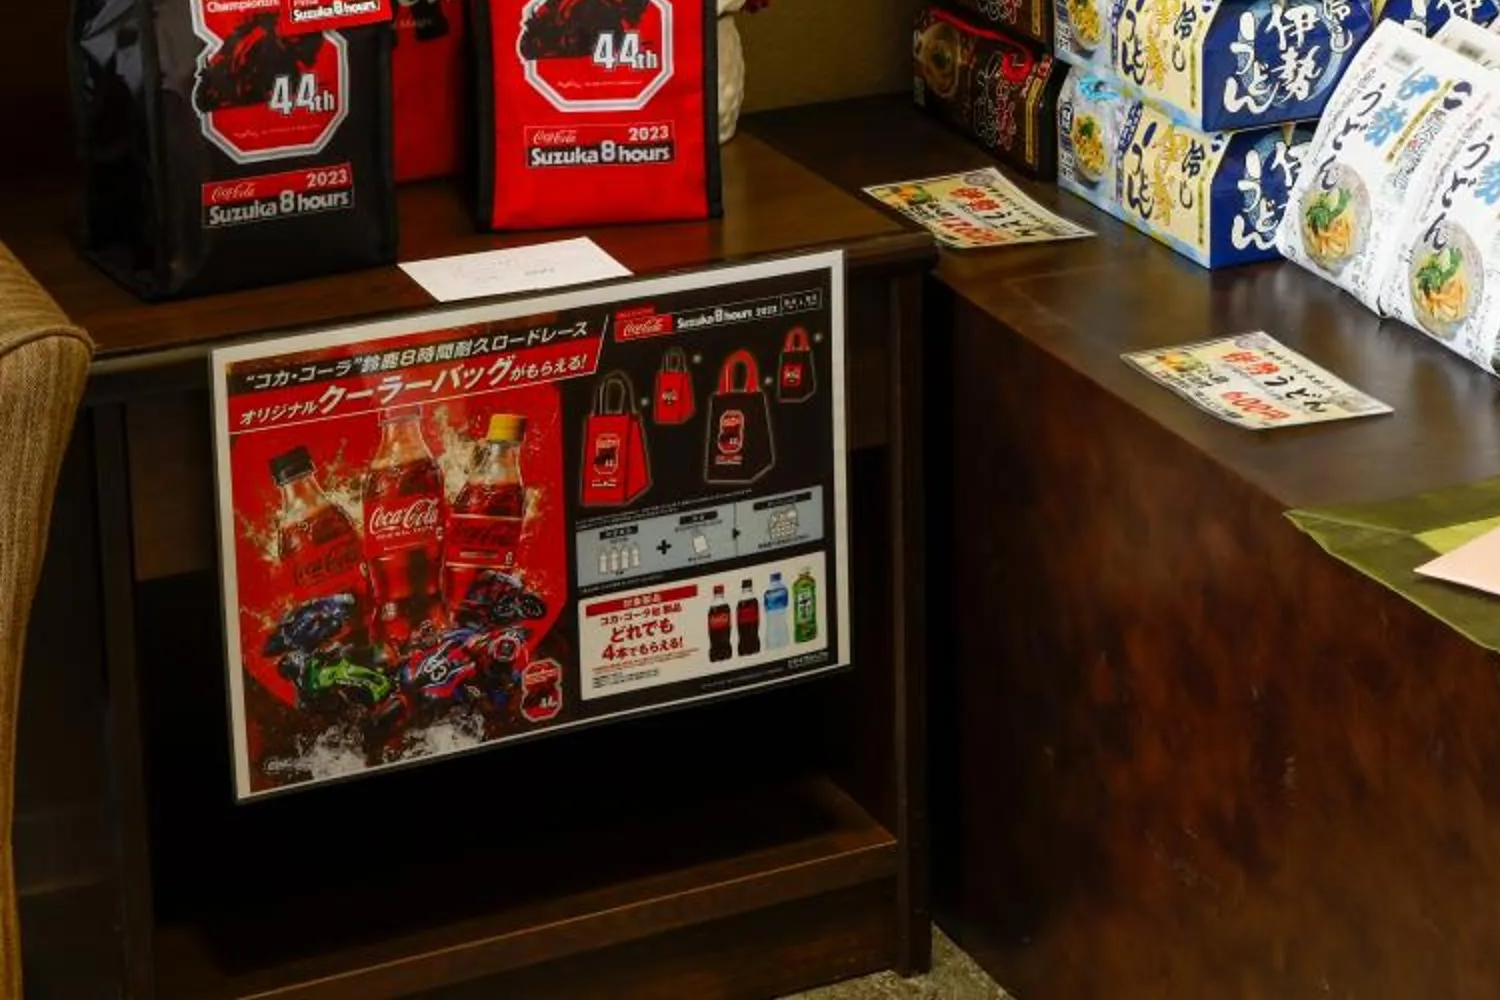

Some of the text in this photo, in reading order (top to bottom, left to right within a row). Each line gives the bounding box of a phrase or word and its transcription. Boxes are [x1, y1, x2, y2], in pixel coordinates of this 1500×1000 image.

[293, 4, 333, 23] Suzuka
[342, 0, 377, 13] hours
[592, 31, 658, 70] 44th
[268, 71, 335, 116] 44th
[628, 125, 669, 143] 2023
[530, 140, 671, 167] Suzuka 8 hours
[305, 169, 349, 190] 2023
[208, 188, 349, 226] Suzuka 8 hours
[610, 616, 674, 644] どれでも
